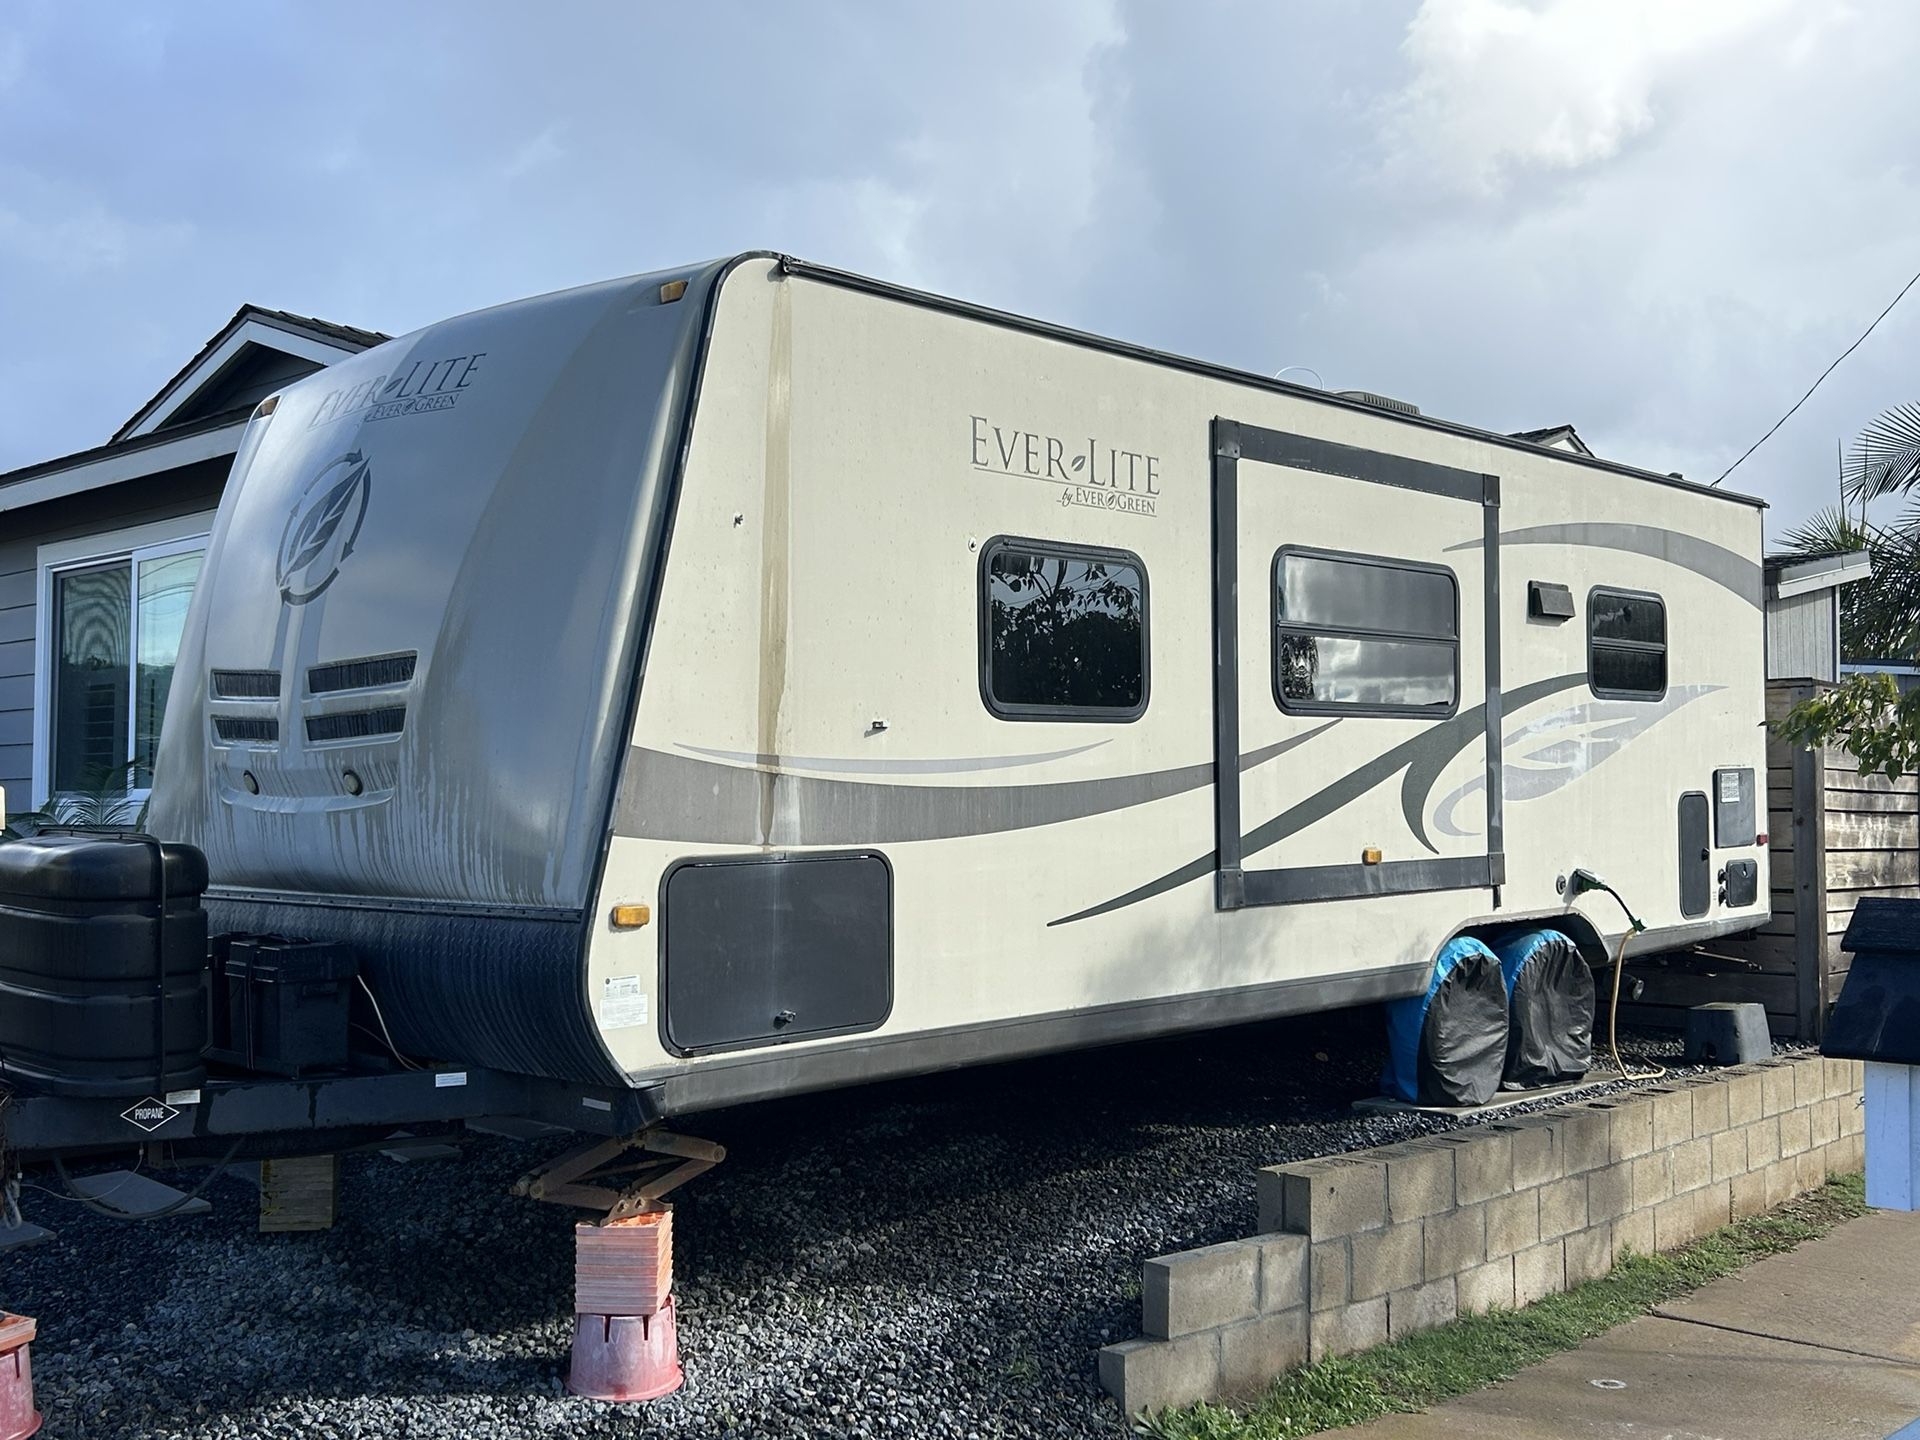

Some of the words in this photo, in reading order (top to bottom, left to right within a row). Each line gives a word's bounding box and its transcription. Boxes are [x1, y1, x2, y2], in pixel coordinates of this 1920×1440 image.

[308, 375, 387, 428] EVER
[395, 353, 487, 398] LITE
[969, 415, 1071, 481] EVER
[1088, 437, 1161, 495] LITE
[1061, 488, 1074, 508] by
[134, 1107, 165, 1121] PROPANE
